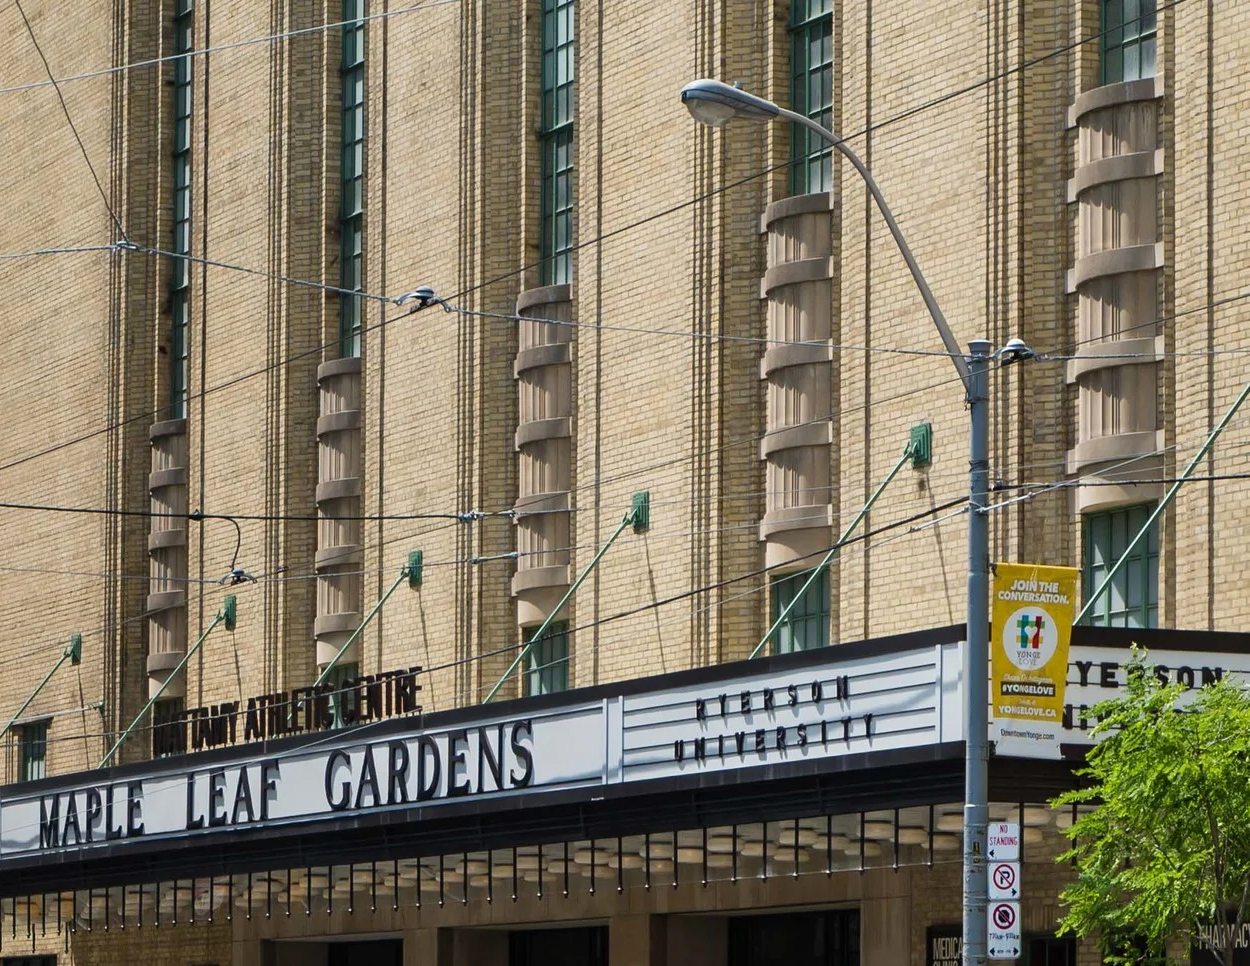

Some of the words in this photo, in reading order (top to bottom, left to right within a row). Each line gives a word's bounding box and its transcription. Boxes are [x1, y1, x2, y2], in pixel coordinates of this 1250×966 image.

[1011, 580, 1037, 592] JOIN
[1039, 582, 1059, 593] THE
[998, 591, 1070, 604] CONVERSATION.
[1066, 661, 1223, 689] YESON
[341, 666, 423, 725] CENTRE
[1002, 684, 1054, 695] #YONGELOVE
[696, 675, 848, 721] RYERSON
[999, 705, 1056, 717] YONGELOVE.CA
[674, 713, 873, 763] UNIVERSITY
[1000, 728, 1055, 740] DowntownYonge.com
[39, 780, 145, 850] MAPLE
[186, 759, 281, 830] LEAF
[325, 721, 535, 811] GARDENS
[1000, 825, 1008, 833] NO
[989, 837, 1017, 846] STANDING
[933, 937, 963, 960] MEDICA
